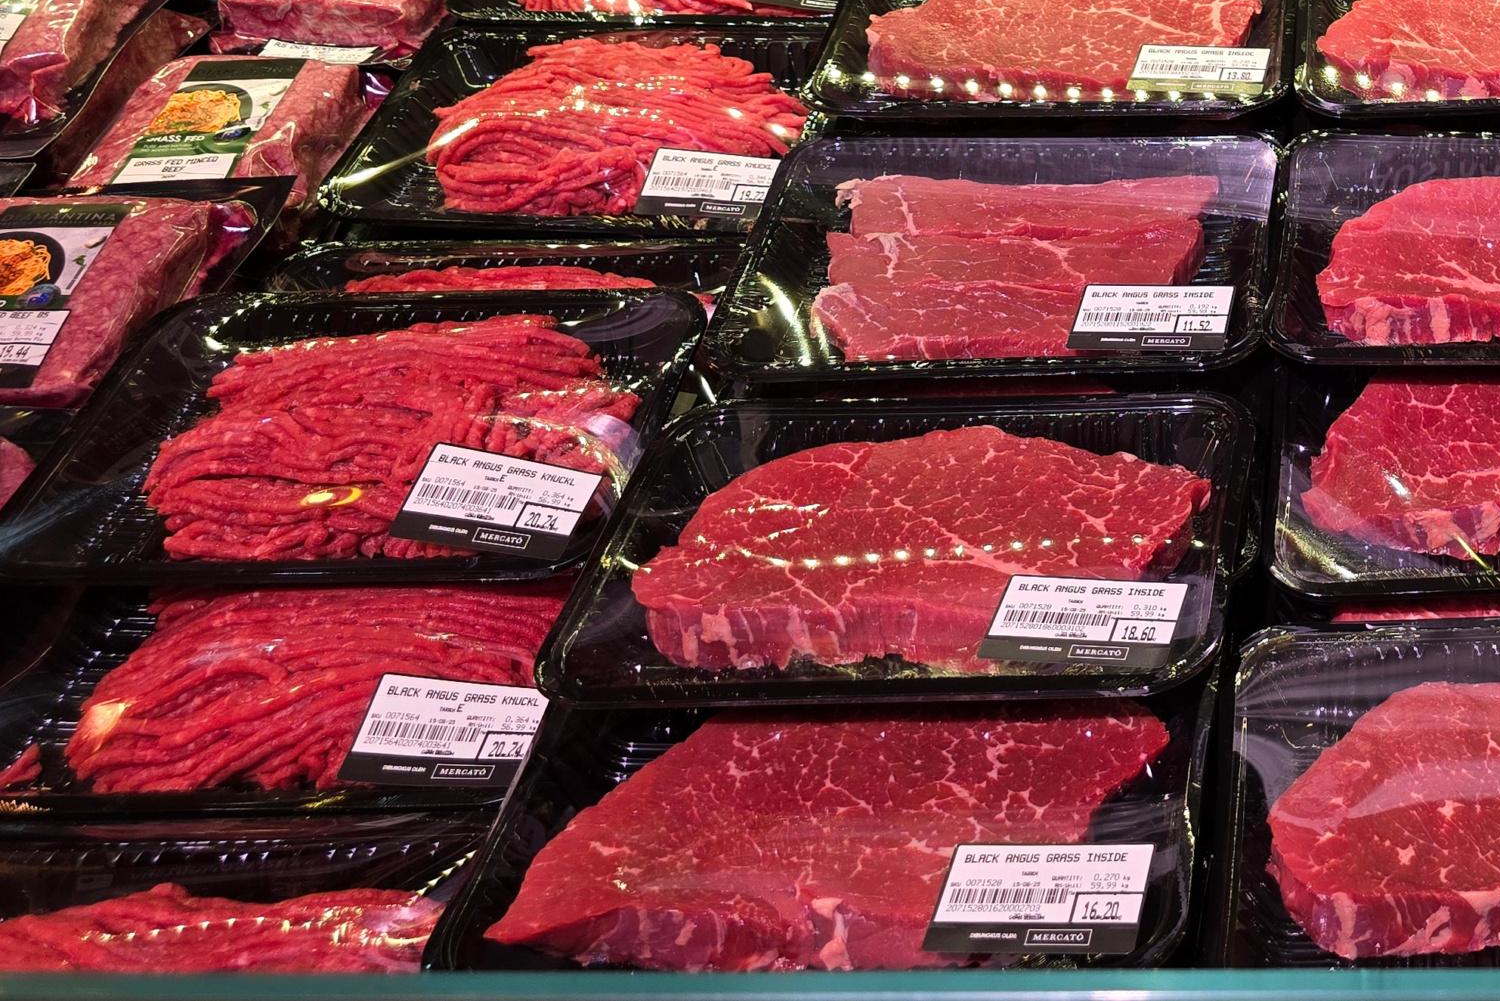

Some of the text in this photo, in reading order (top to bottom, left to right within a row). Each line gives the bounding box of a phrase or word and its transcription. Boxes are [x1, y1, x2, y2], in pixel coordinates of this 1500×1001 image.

[439, 454, 575, 486] BLACK ANGUS GRASS KNUCKL
[1019, 584, 1165, 596] BLACK ANGUS GRASS INSIDE
[387, 686, 539, 706] BLACK ANGUS GRASS KNUCKL
[965, 853, 1128, 863] BLACK ANGUS GRASS INSIDE
